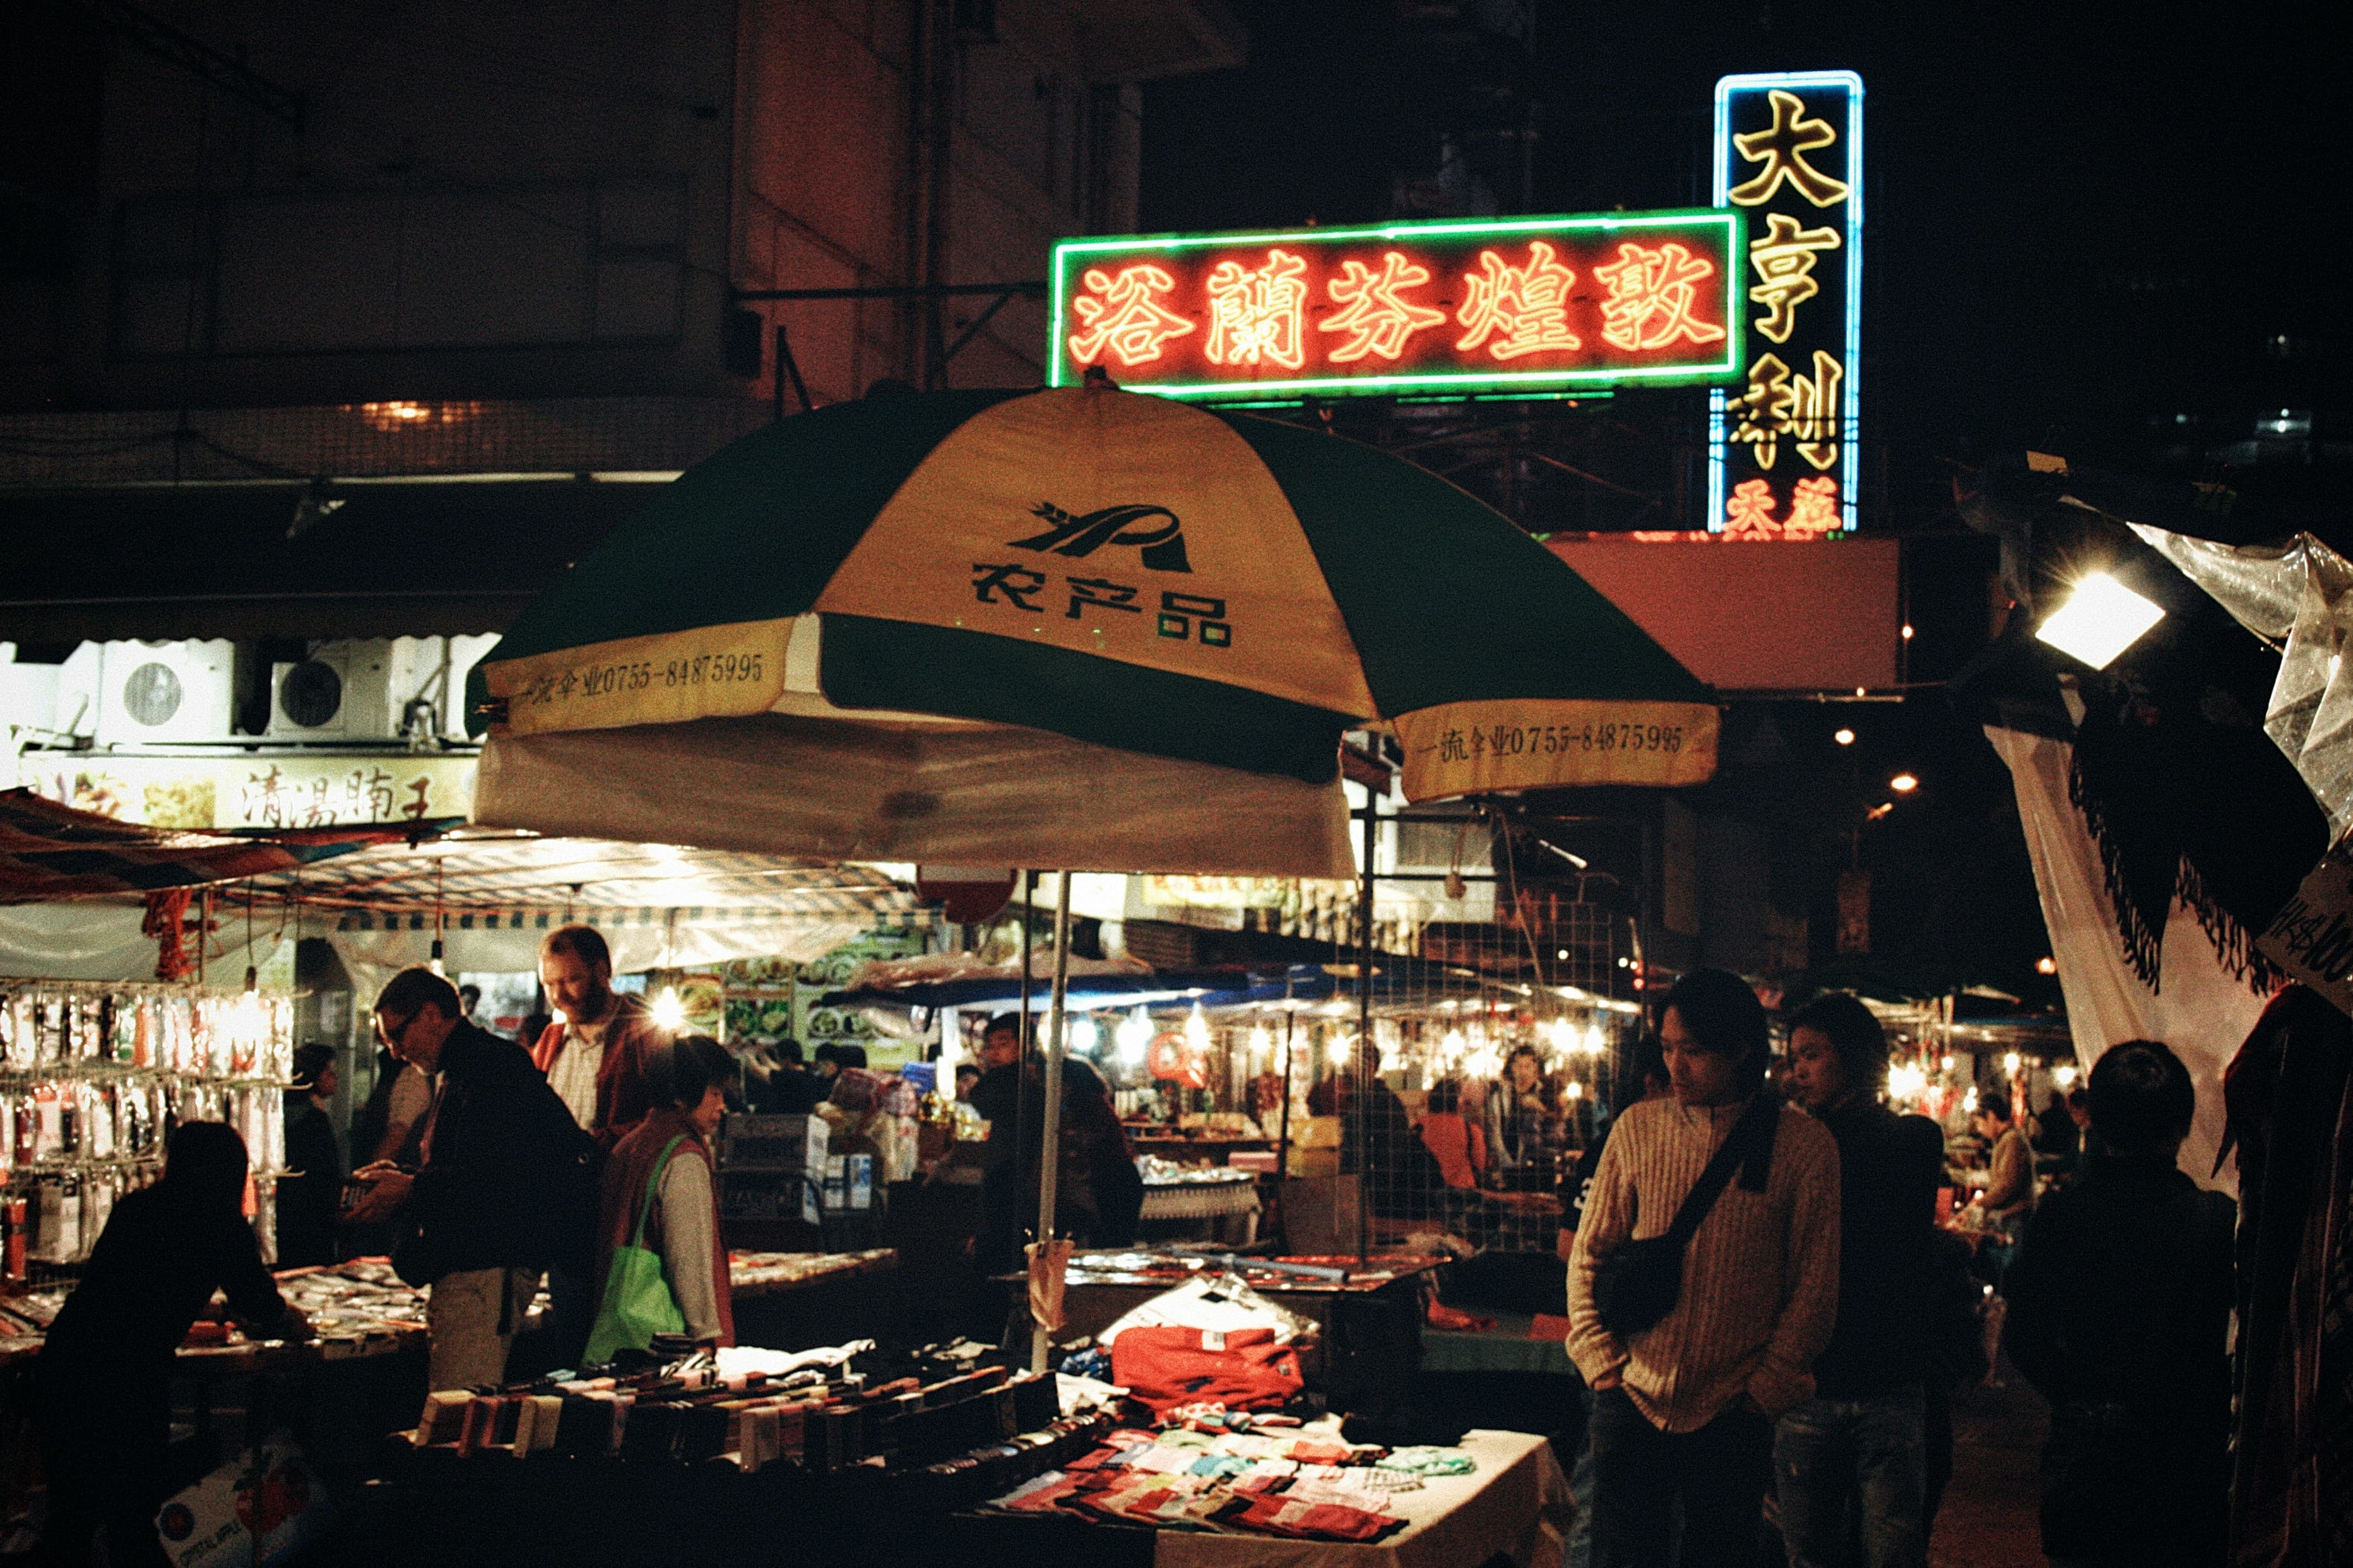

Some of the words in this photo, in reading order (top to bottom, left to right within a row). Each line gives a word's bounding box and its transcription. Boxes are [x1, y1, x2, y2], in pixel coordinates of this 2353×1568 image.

[1727, 88, 1849, 469] 大亨利
[972, 563, 1232, 648] 农产品
